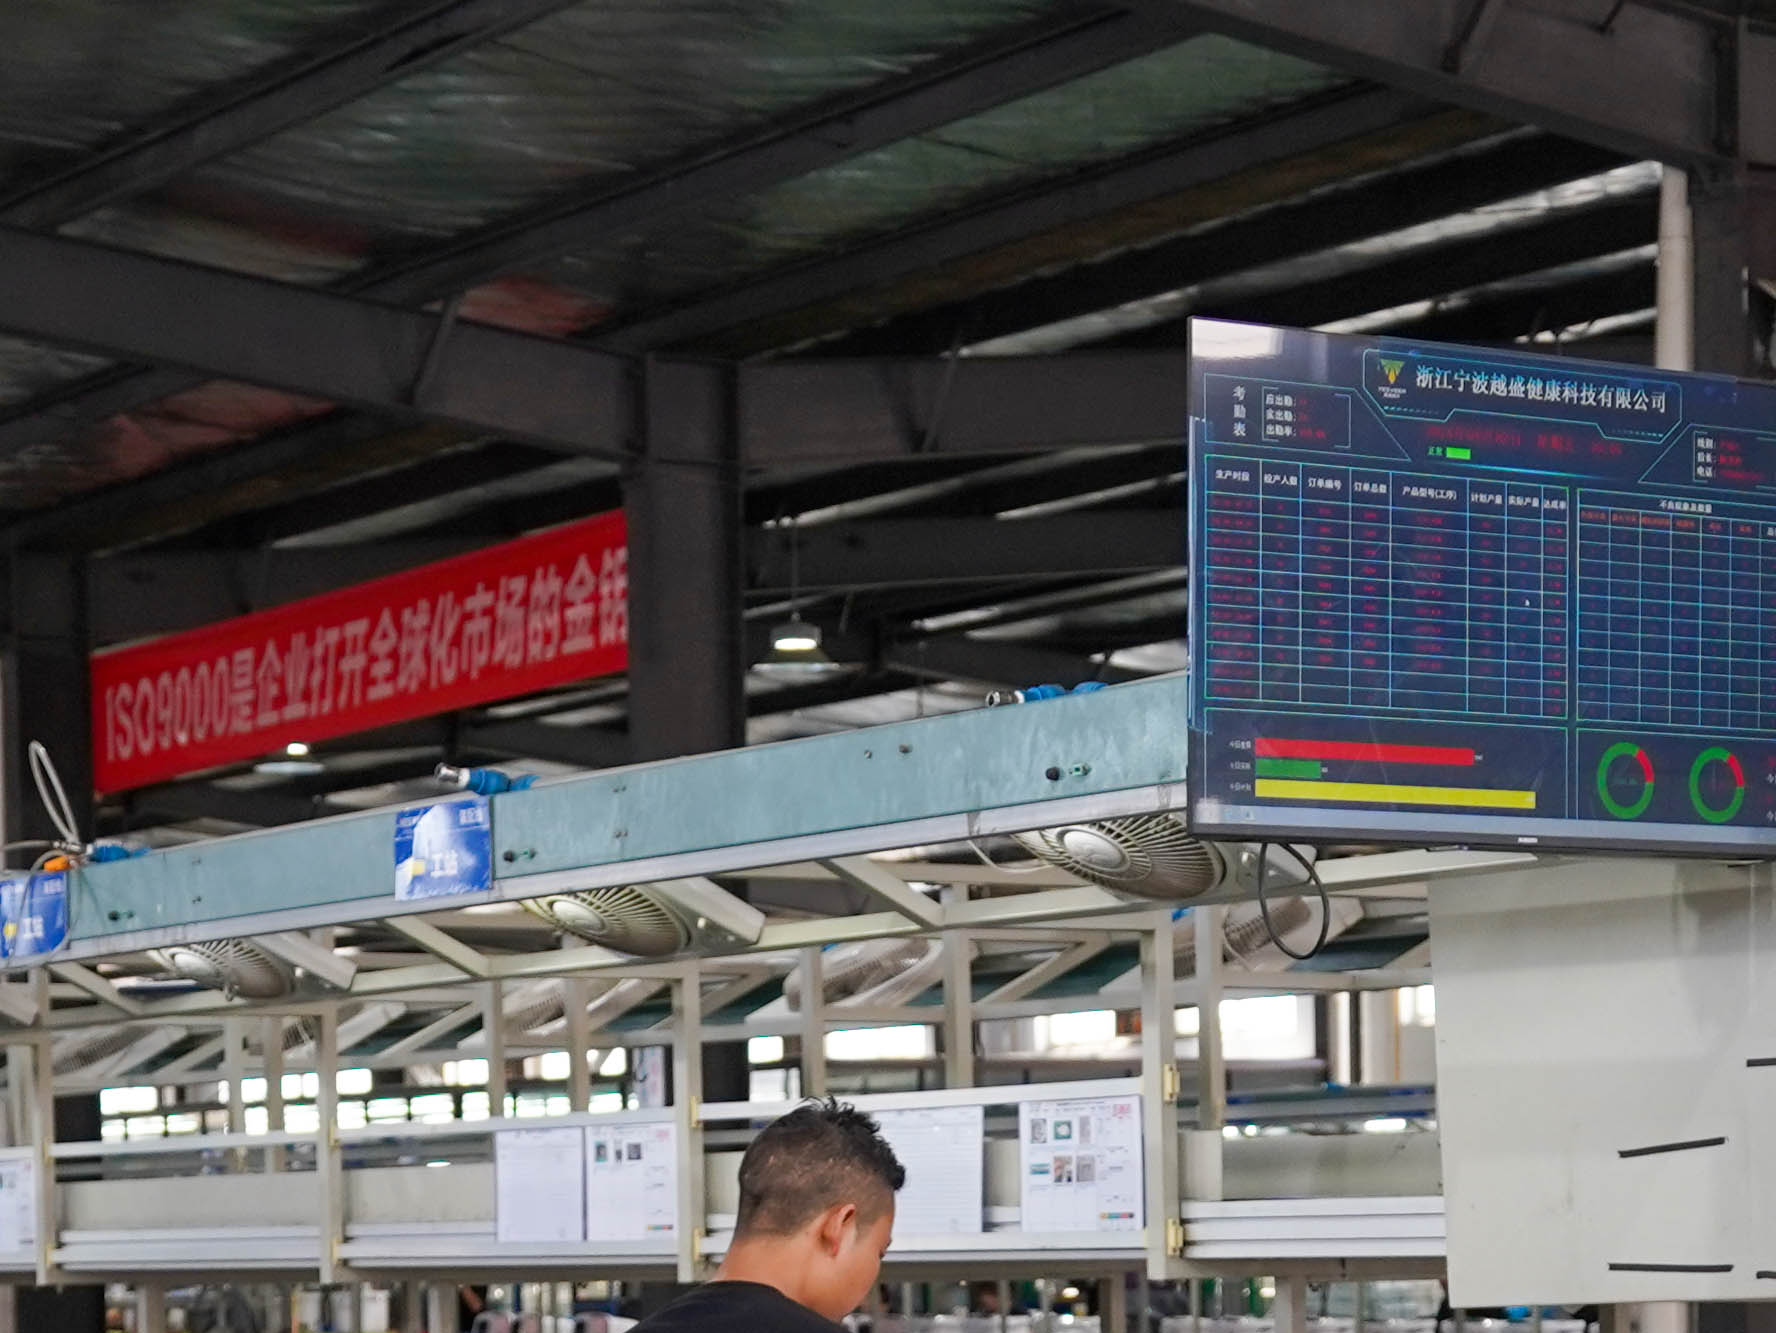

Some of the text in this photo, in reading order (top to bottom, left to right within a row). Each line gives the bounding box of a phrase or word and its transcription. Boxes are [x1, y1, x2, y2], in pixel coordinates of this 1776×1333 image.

[1232, 385, 1247, 437] 考勤表
[1415, 364, 1667, 414] 浙江宁波越盛健康科技有限公司
[1307, 477, 1342, 491] 订单编号
